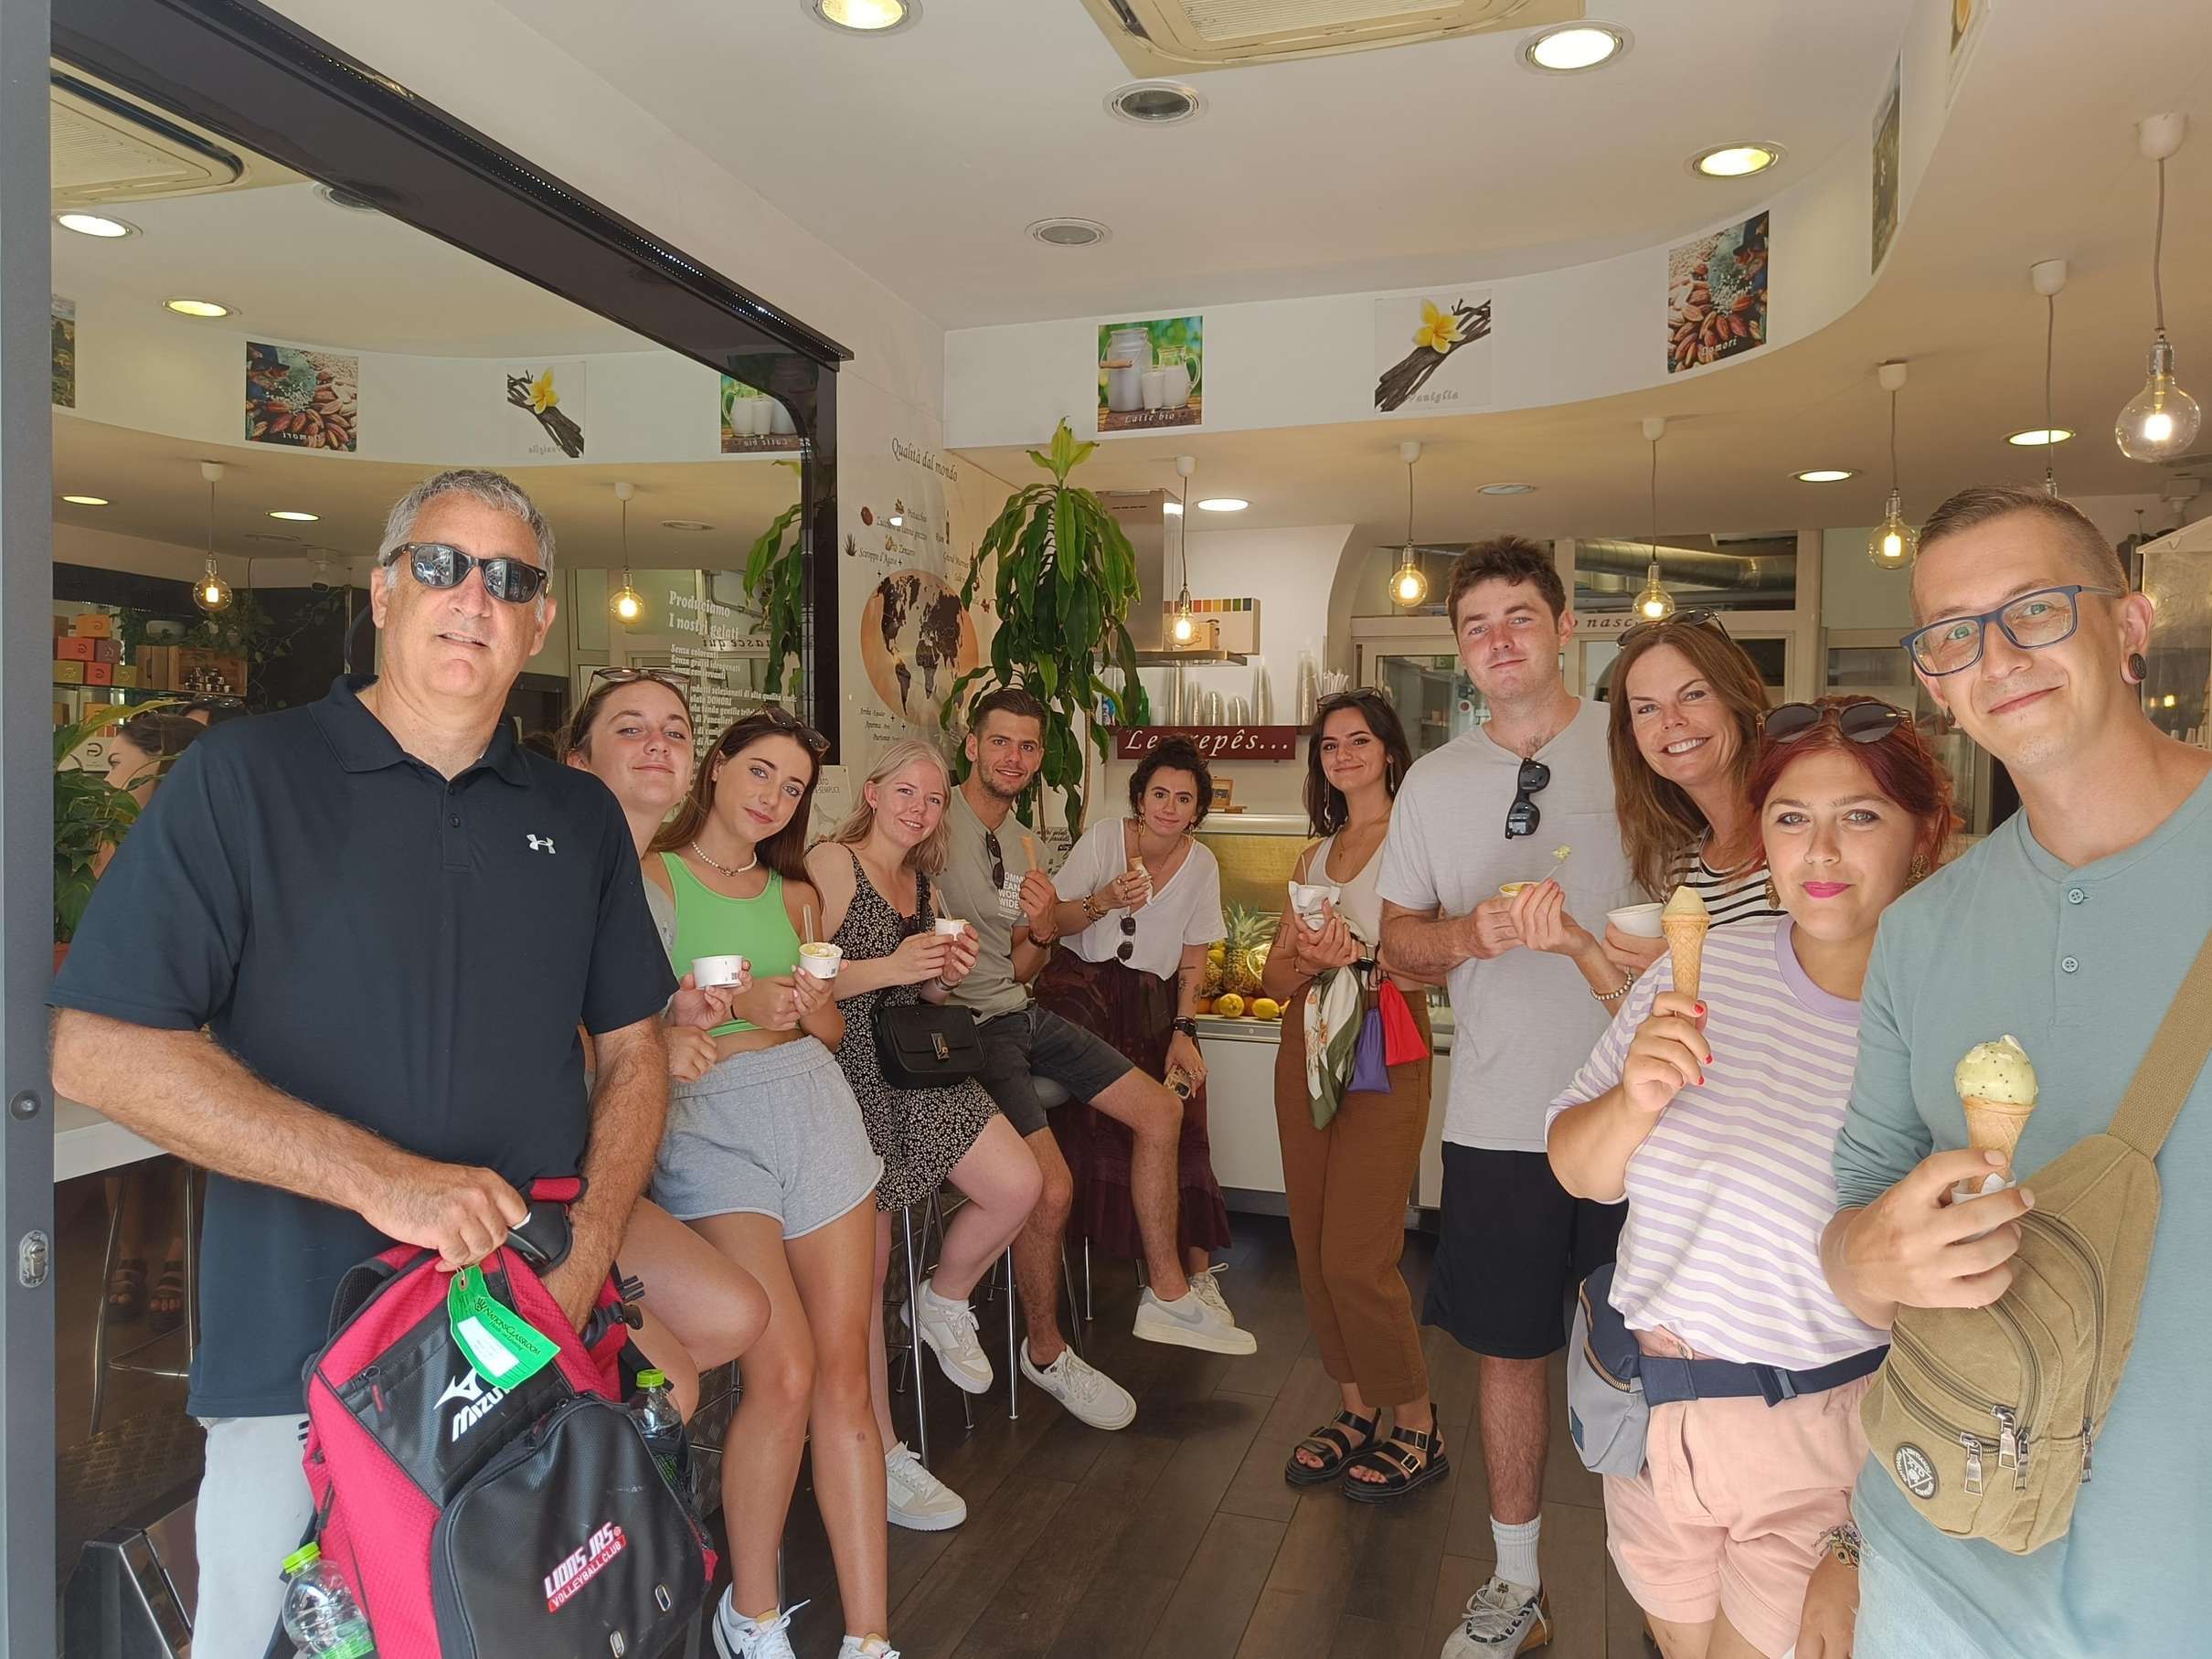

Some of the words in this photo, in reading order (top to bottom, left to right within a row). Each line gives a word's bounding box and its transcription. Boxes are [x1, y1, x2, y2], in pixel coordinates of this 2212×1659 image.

[1124, 413, 1155, 423] Latte
[1158, 410, 1185, 420] bio
[892, 437, 920, 464] Qualità
[921, 451, 935, 471] dal
[935, 462, 958, 483] mondo
[668, 590, 731, 618] Produciamo
[709, 623, 739, 641] gelati
[1587, 618, 1639, 629] nasc
[998, 897, 1020, 909] WIDE
[452, 1386, 511, 1442] MIZU
[544, 1546, 588, 1600] LIONS
[588, 1521, 614, 1562] JRS
[551, 1558, 605, 1608] VOLLEYBALL
[601, 1540, 622, 1564] CLUB
